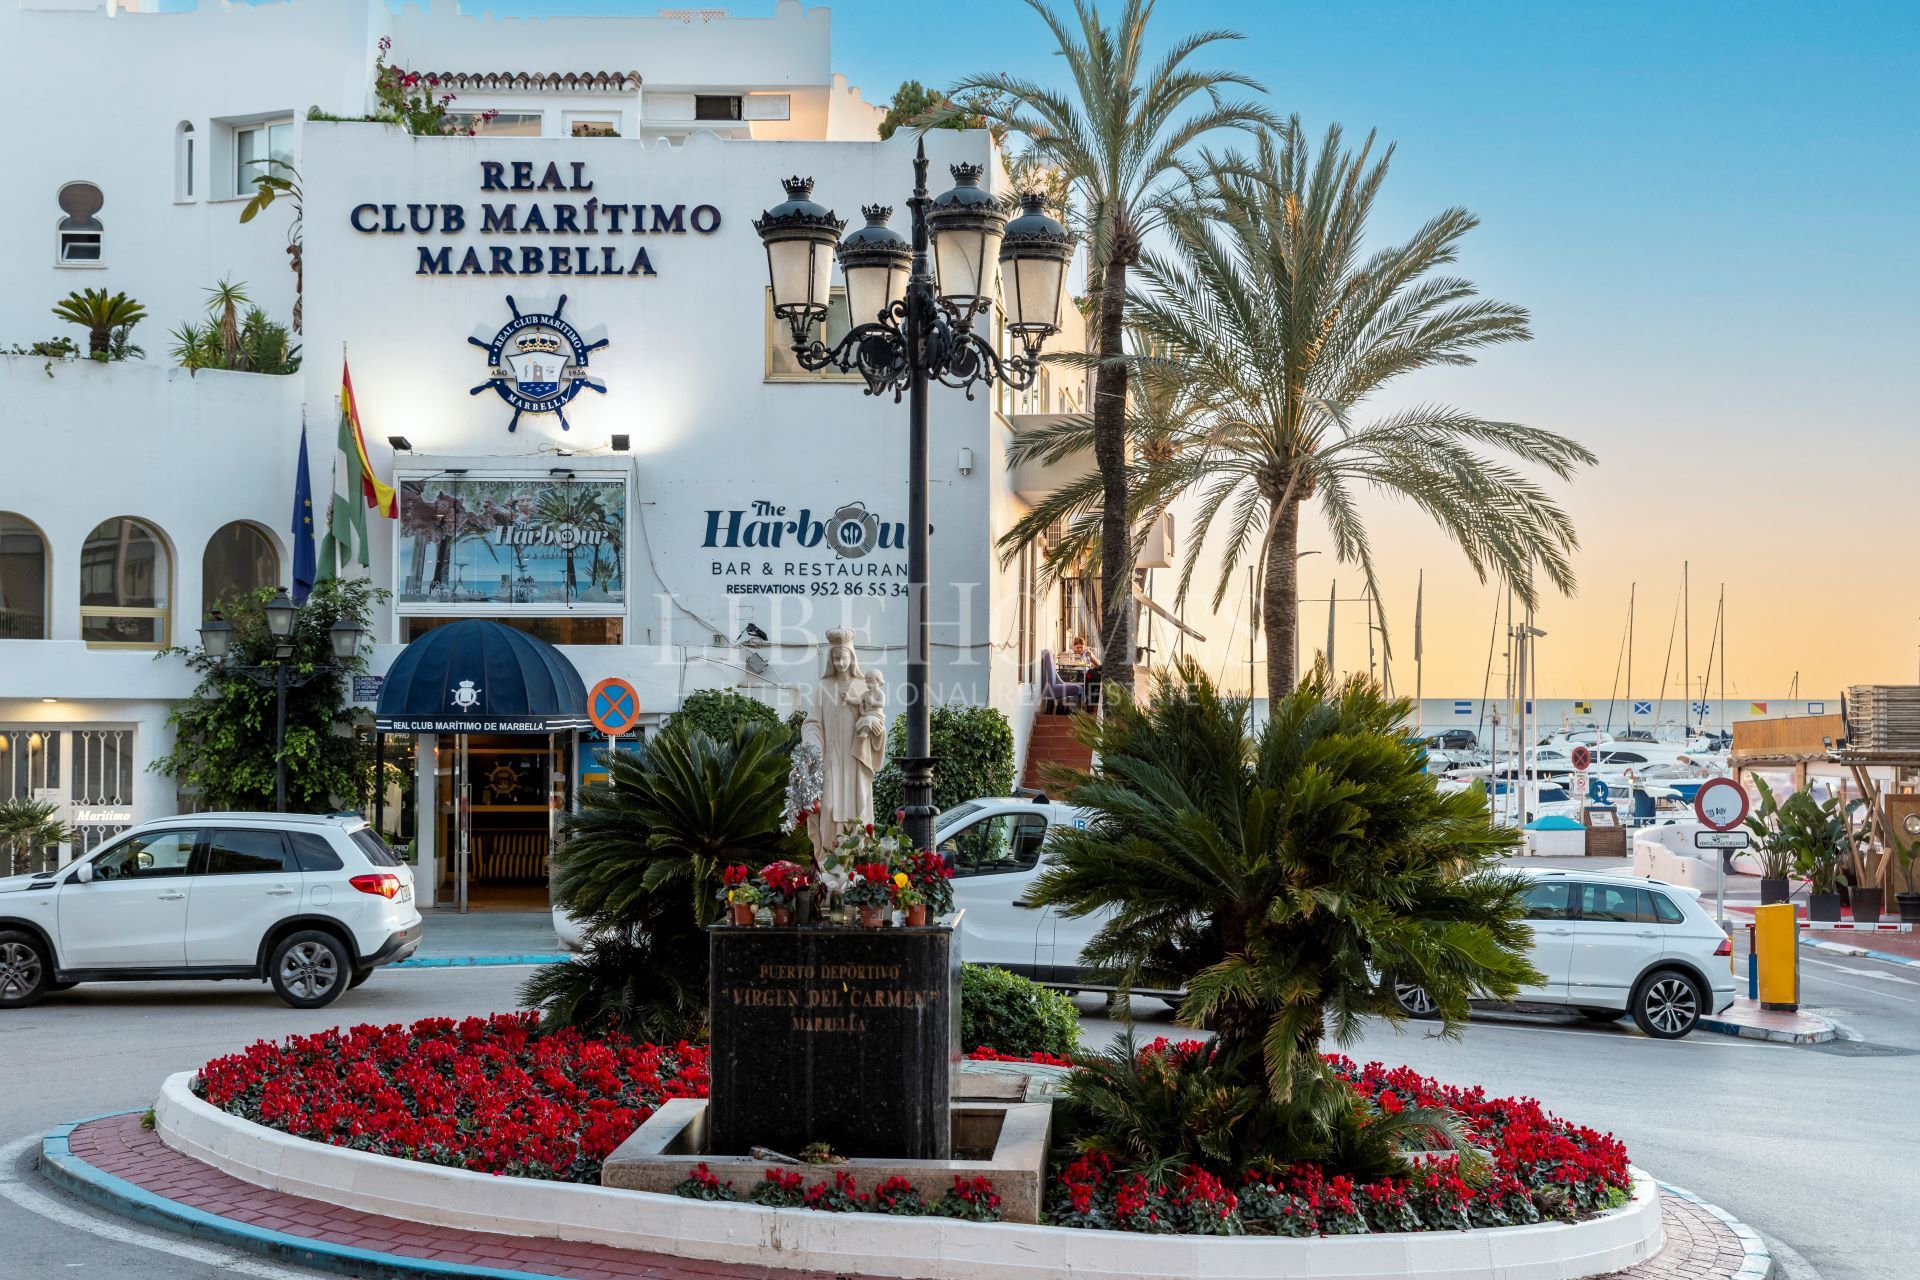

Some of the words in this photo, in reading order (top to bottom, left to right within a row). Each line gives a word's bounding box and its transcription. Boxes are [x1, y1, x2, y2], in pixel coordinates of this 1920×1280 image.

[480, 161, 594, 192] REAL
[350, 203, 466, 234] CLUB
[480, 196, 722, 234] MARÍTIMO
[415, 246, 658, 276] MARBELLA
[495, 327, 515, 347] REAL
[513, 315, 539, 328] CLUB
[540, 315, 582, 348] MARÍTIMO
[491, 368, 508, 377] AÑO
[508, 393, 569, 411] MARBELLA
[751, 500, 786, 517] The
[494, 522, 609, 550] Harbour
[700, 501, 934, 559] Harbou
[712, 562, 751, 576] BAR
[762, 561, 774, 576] &
[784, 562, 909, 577] RESTAURAN
[726, 584, 806, 595] RESERVATIONS
[810, 582, 840, 596] 952
[844, 582, 864, 596] 86
[868, 582, 887, 597] 55
[890, 582, 909, 598] 34
[393, 722, 410, 730] REAL
[411, 722, 434, 730] CLUB
[435, 720, 482, 730] MARÍTIMO
[484, 722, 497, 730] DE
[499, 722, 544, 731] MARBELLA
[759, 964, 815, 980] PUERTO
[820, 964, 900, 980] DEPORTIVO
[807, 988, 844, 1008] DEL
